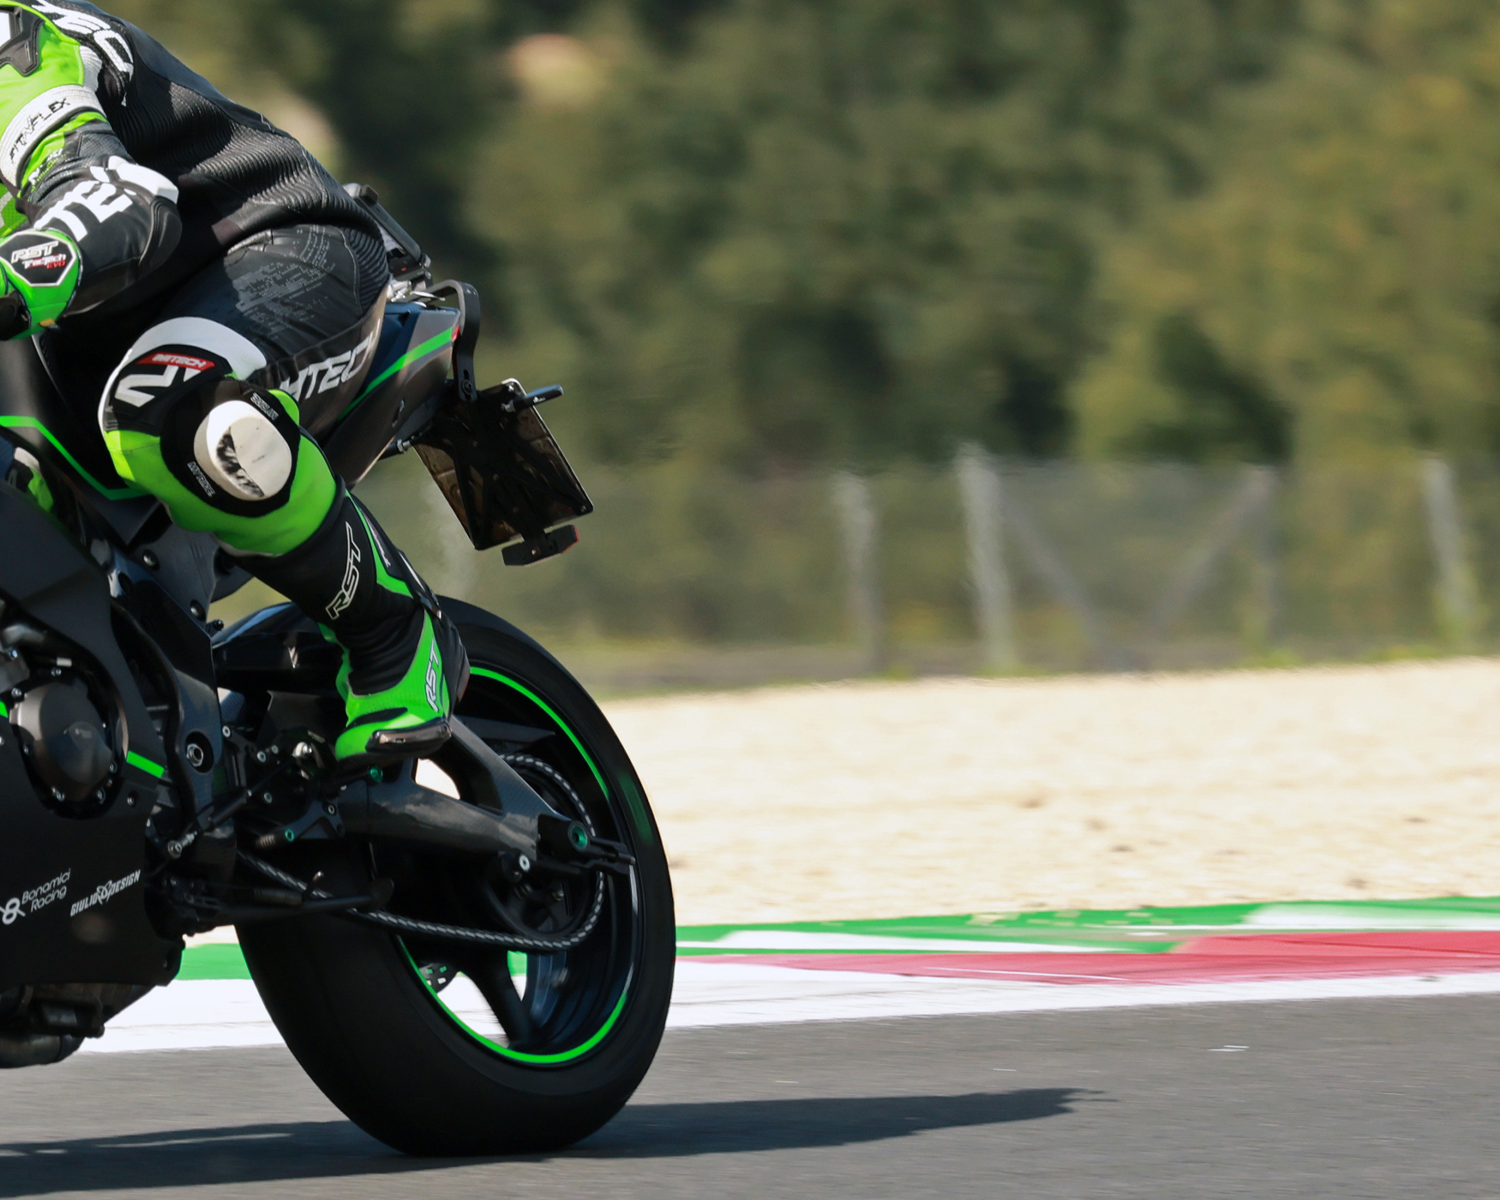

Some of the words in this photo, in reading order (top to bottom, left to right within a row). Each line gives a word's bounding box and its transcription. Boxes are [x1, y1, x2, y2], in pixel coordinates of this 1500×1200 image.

[11, 241, 59, 264] RST
[325, 521, 361, 620] RST
[425, 637, 439, 713] RST
[21, 867, 71, 905] Bonamici
[31, 885, 67, 913] Racing
